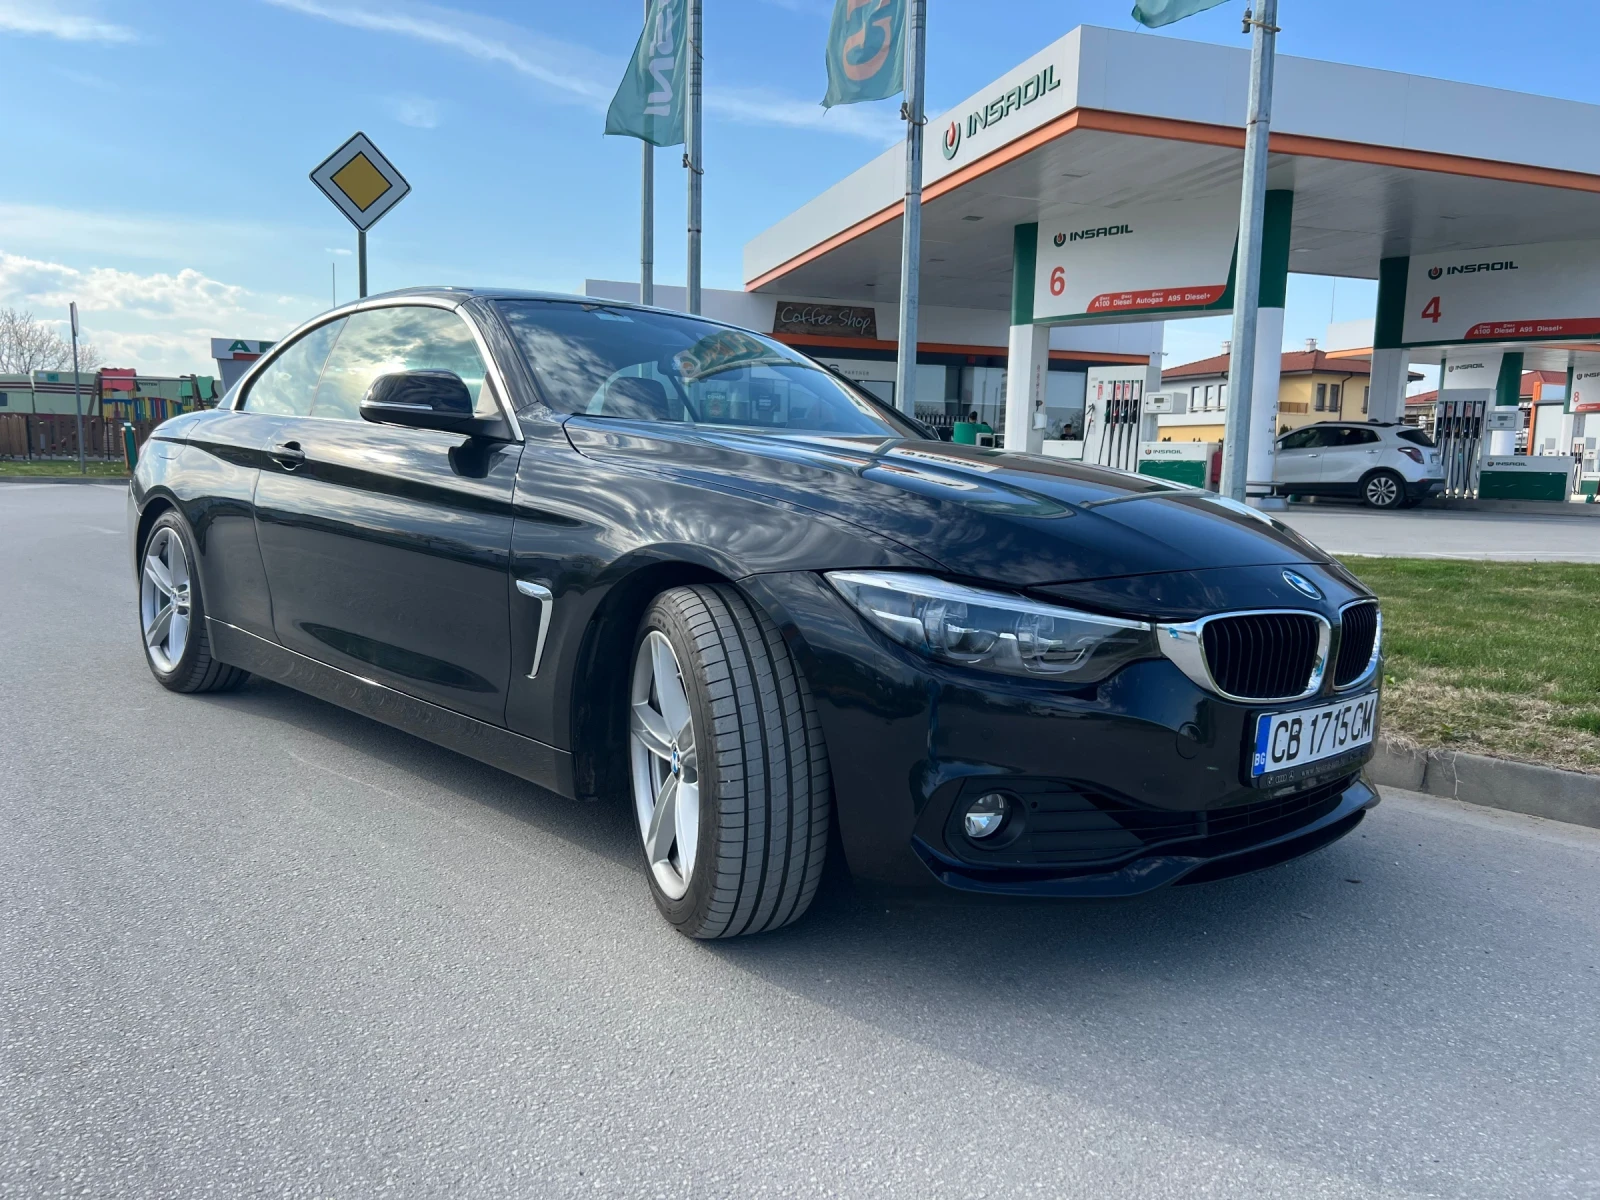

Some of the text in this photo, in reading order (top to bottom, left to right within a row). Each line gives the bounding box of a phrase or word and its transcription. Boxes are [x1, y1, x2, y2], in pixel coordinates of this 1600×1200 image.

[966, 64, 1061, 139] INSAOIL
[1069, 224, 1134, 242] INSAOIL
[1446, 261, 1519, 275] INSAOIL
[1049, 266, 1066, 297] 6
[1094, 300, 1110, 308] A100
[1113, 298, 1132, 306] Diesel
[1136, 296, 1163, 305] Autogas
[1167, 294, 1181, 302] A95
[1185, 292, 1211, 301] Diesel+
[1421, 296, 1442, 323] 4
[781, 306, 871, 335] Coffee Shop
[1573, 391, 1580, 403] 8
[1271, 699, 1375, 764] CB 1715 CM
[1254, 752, 1266, 767] BG
